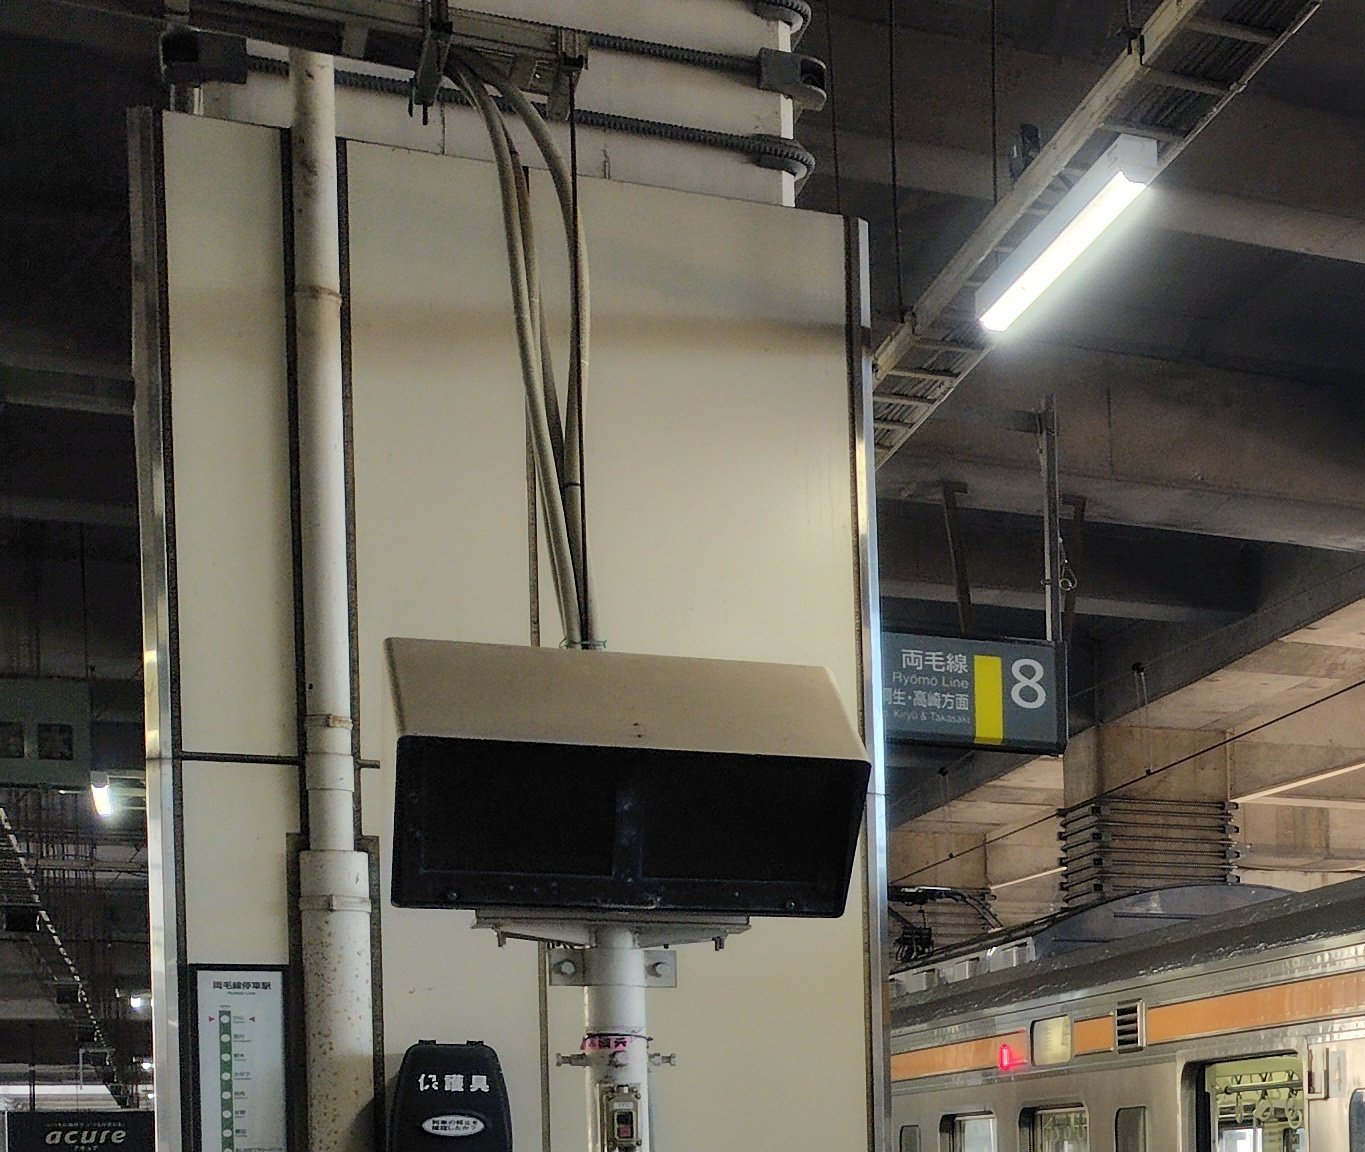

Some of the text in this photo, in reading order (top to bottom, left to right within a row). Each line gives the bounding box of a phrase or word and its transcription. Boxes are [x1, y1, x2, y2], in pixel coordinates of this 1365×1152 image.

[902, 649, 969, 674] 両毛線
[942, 673, 969, 689] Line
[1011, 658, 1047, 709] 8
[45, 1130, 126, 1145] acure
